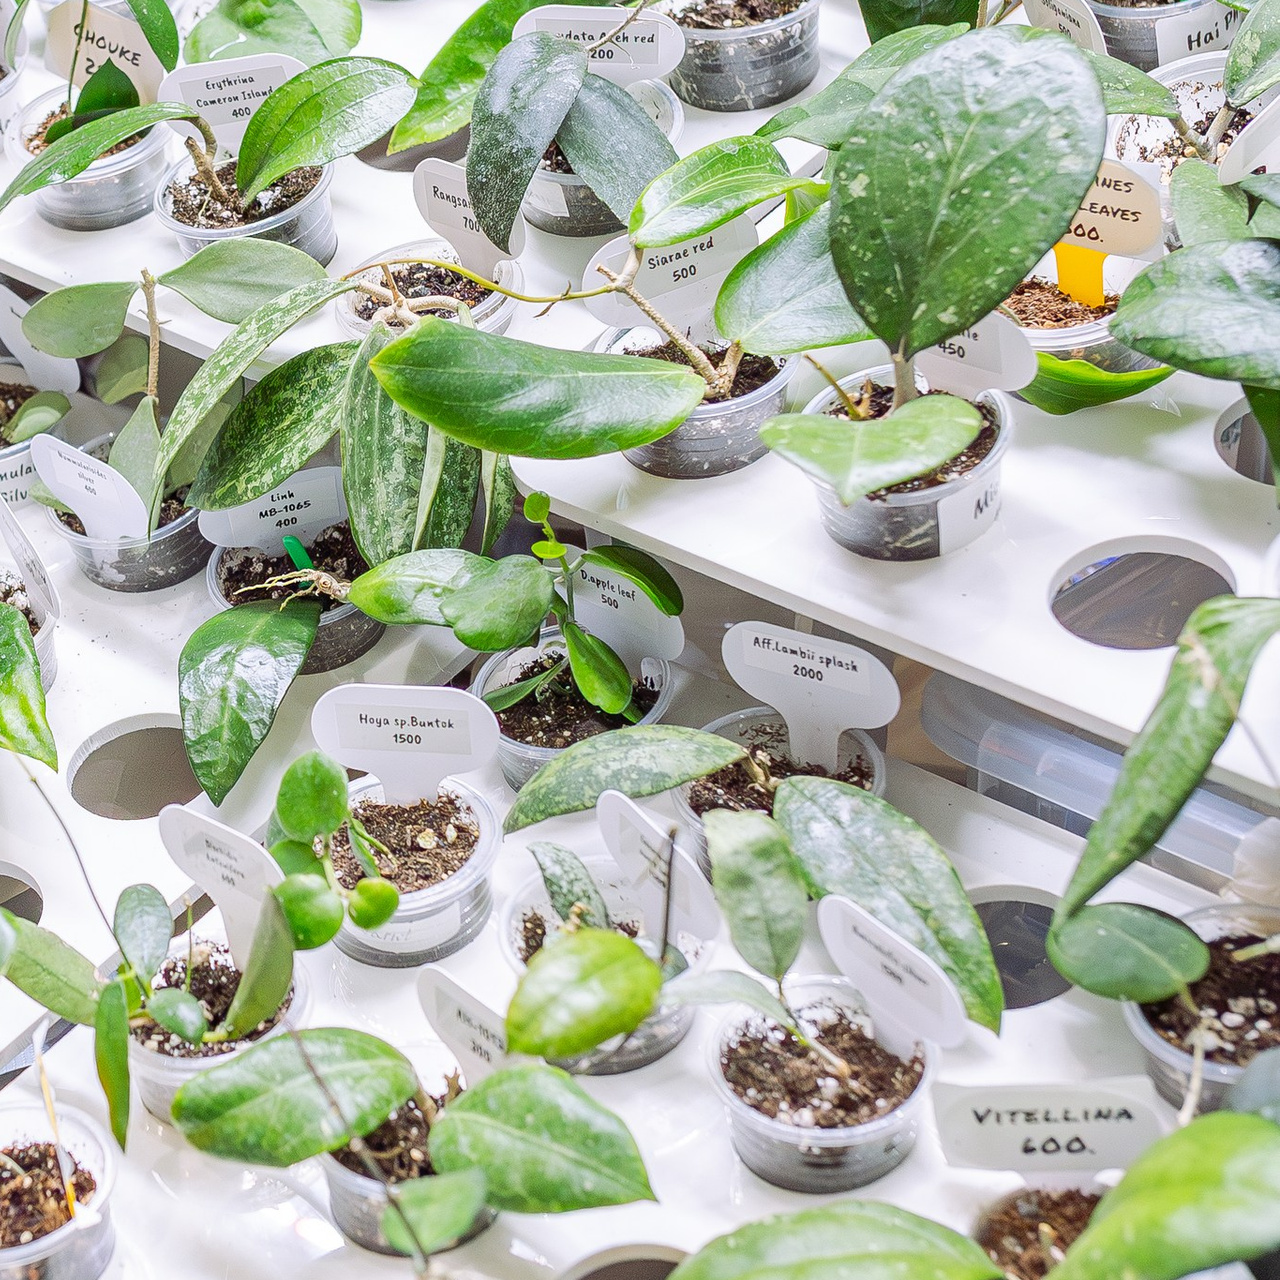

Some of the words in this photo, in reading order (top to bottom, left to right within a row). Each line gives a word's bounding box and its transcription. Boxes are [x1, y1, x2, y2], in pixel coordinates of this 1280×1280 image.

[634, 33, 655, 43] red
[1187, 21, 1219, 51] Hai
[204, 75, 255, 92] Erythrina
[195, 93, 239, 109] Cameron
[241, 86, 274, 101] Island
[231, 107, 251, 119] 400
[648, 249, 690, 270] Siarae
[692, 236, 715, 255] red
[672, 264, 697, 282] 500
[938, 341, 965, 359] 450
[258, 500, 312, 519] MB-1065
[274, 516, 298, 529] 400
[579, 568, 616, 594] D.apple
[617, 584, 637, 602] leaf
[600, 593, 619, 610] 500
[793, 663, 824, 681] 2000
[819, 654, 860, 673] splash
[358, 713, 390, 728] Hoya
[394, 715, 455, 730] sp.Buntok
[392, 733, 422, 745] 1500
[971, 1107, 1134, 1125] VITELLINA
